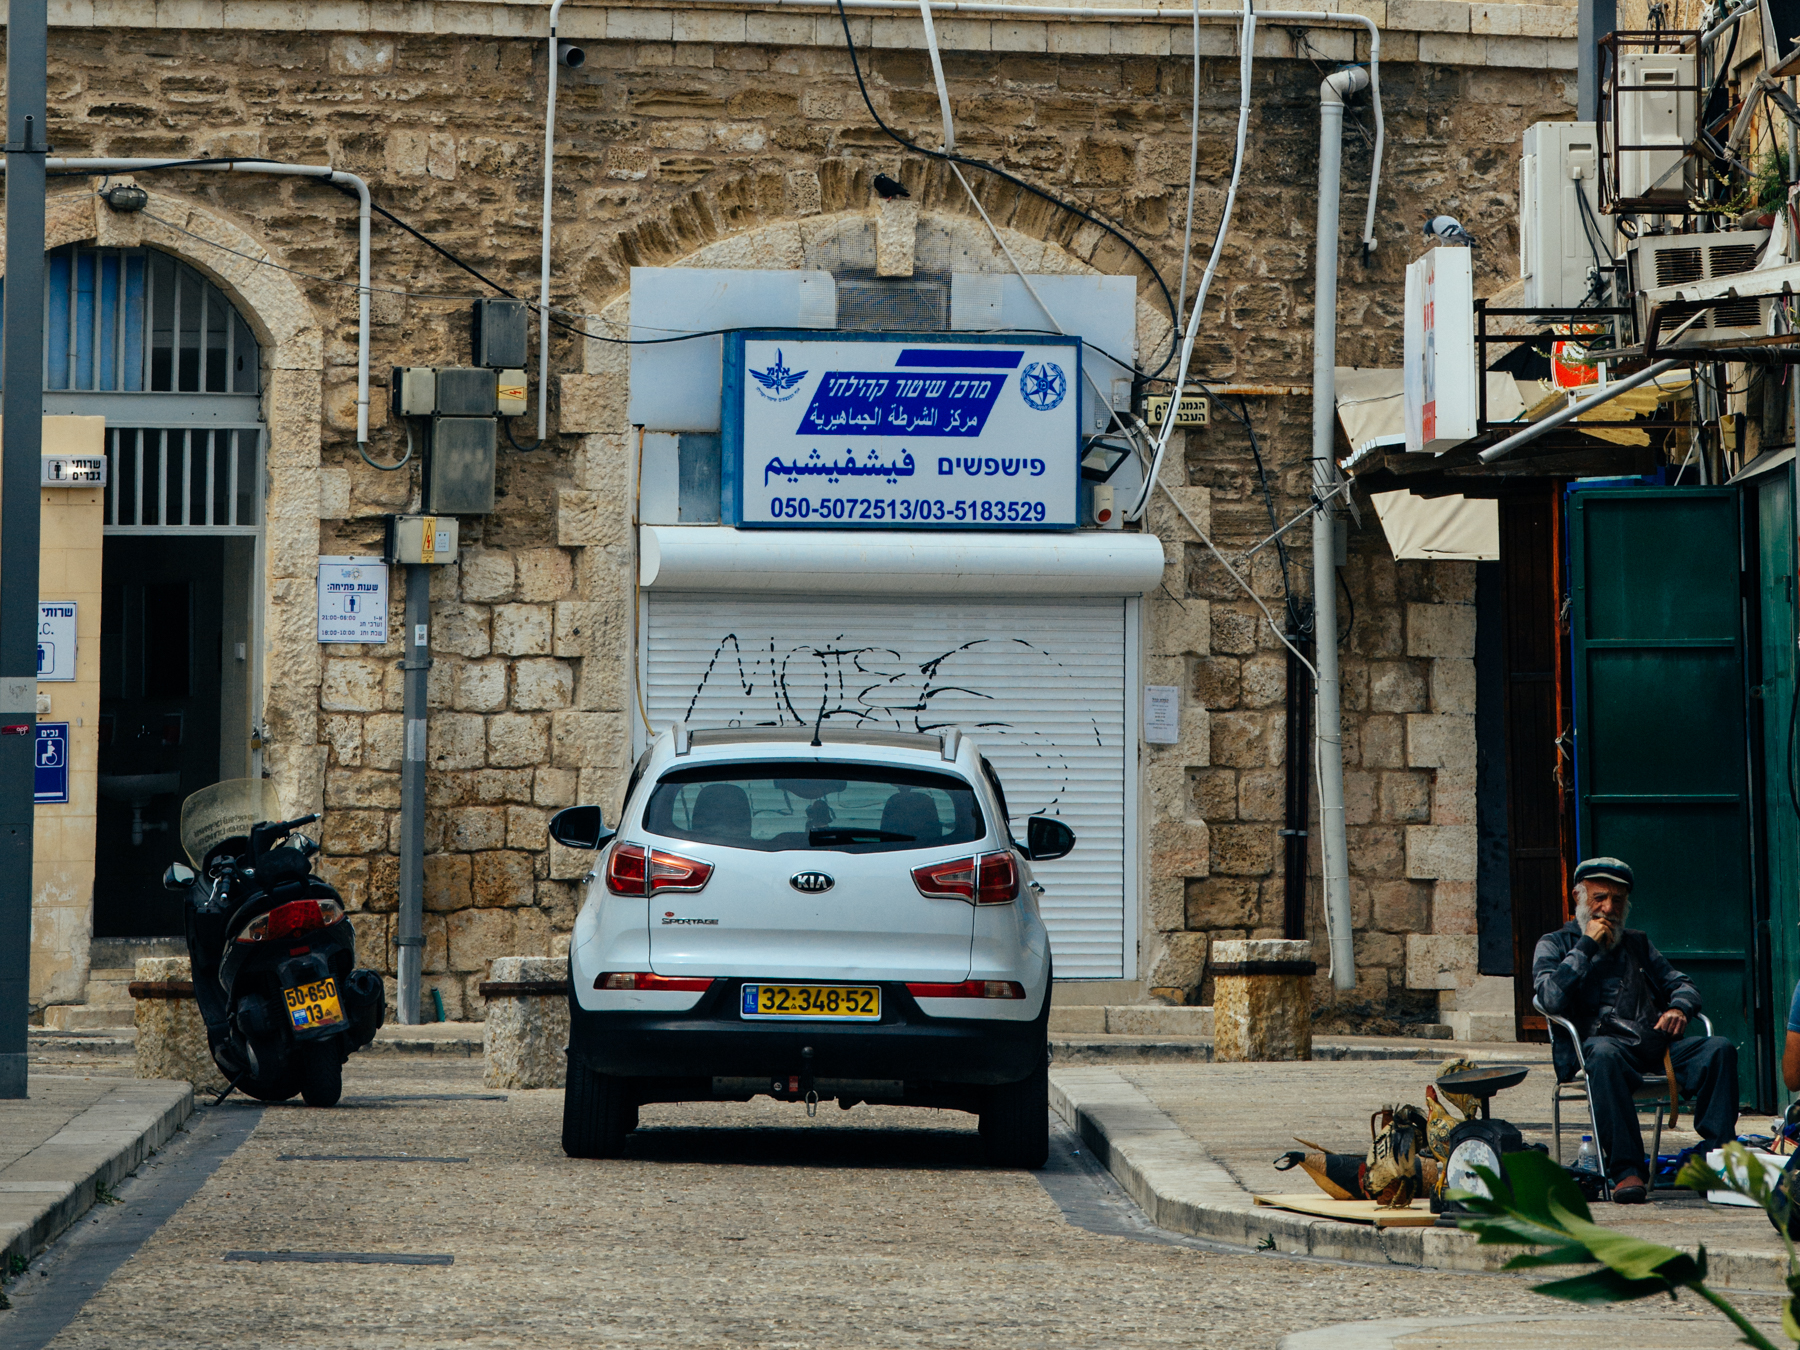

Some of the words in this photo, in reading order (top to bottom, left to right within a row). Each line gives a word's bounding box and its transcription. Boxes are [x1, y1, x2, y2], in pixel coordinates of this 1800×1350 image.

[829, 375, 889, 402] קהילתי
[895, 379, 946, 398] שיטור
[948, 380, 992, 399] מרכז
[809, 402, 882, 431] الجماهيرية
[887, 403, 939, 432] الشرطة
[943, 408, 978, 432] مركز
[1154, 404, 1162, 421] 6
[71, 459, 101, 469] שרותי
[764, 447, 915, 488] فيشفيشيم
[937, 457, 1046, 477] פישפשים
[72, 471, 101, 481] גברים
[770, 497, 1046, 522] 050-5072513/03-5183529
[327, 583, 355, 591] פתיחה:
[356, 583, 379, 592] שעות
[41, 607, 73, 618] שרותי
[41, 729, 59, 738] נכים
[798, 875, 827, 889] KIA
[746, 994, 755, 1005] IL
[306, 1003, 324, 1022] 13
